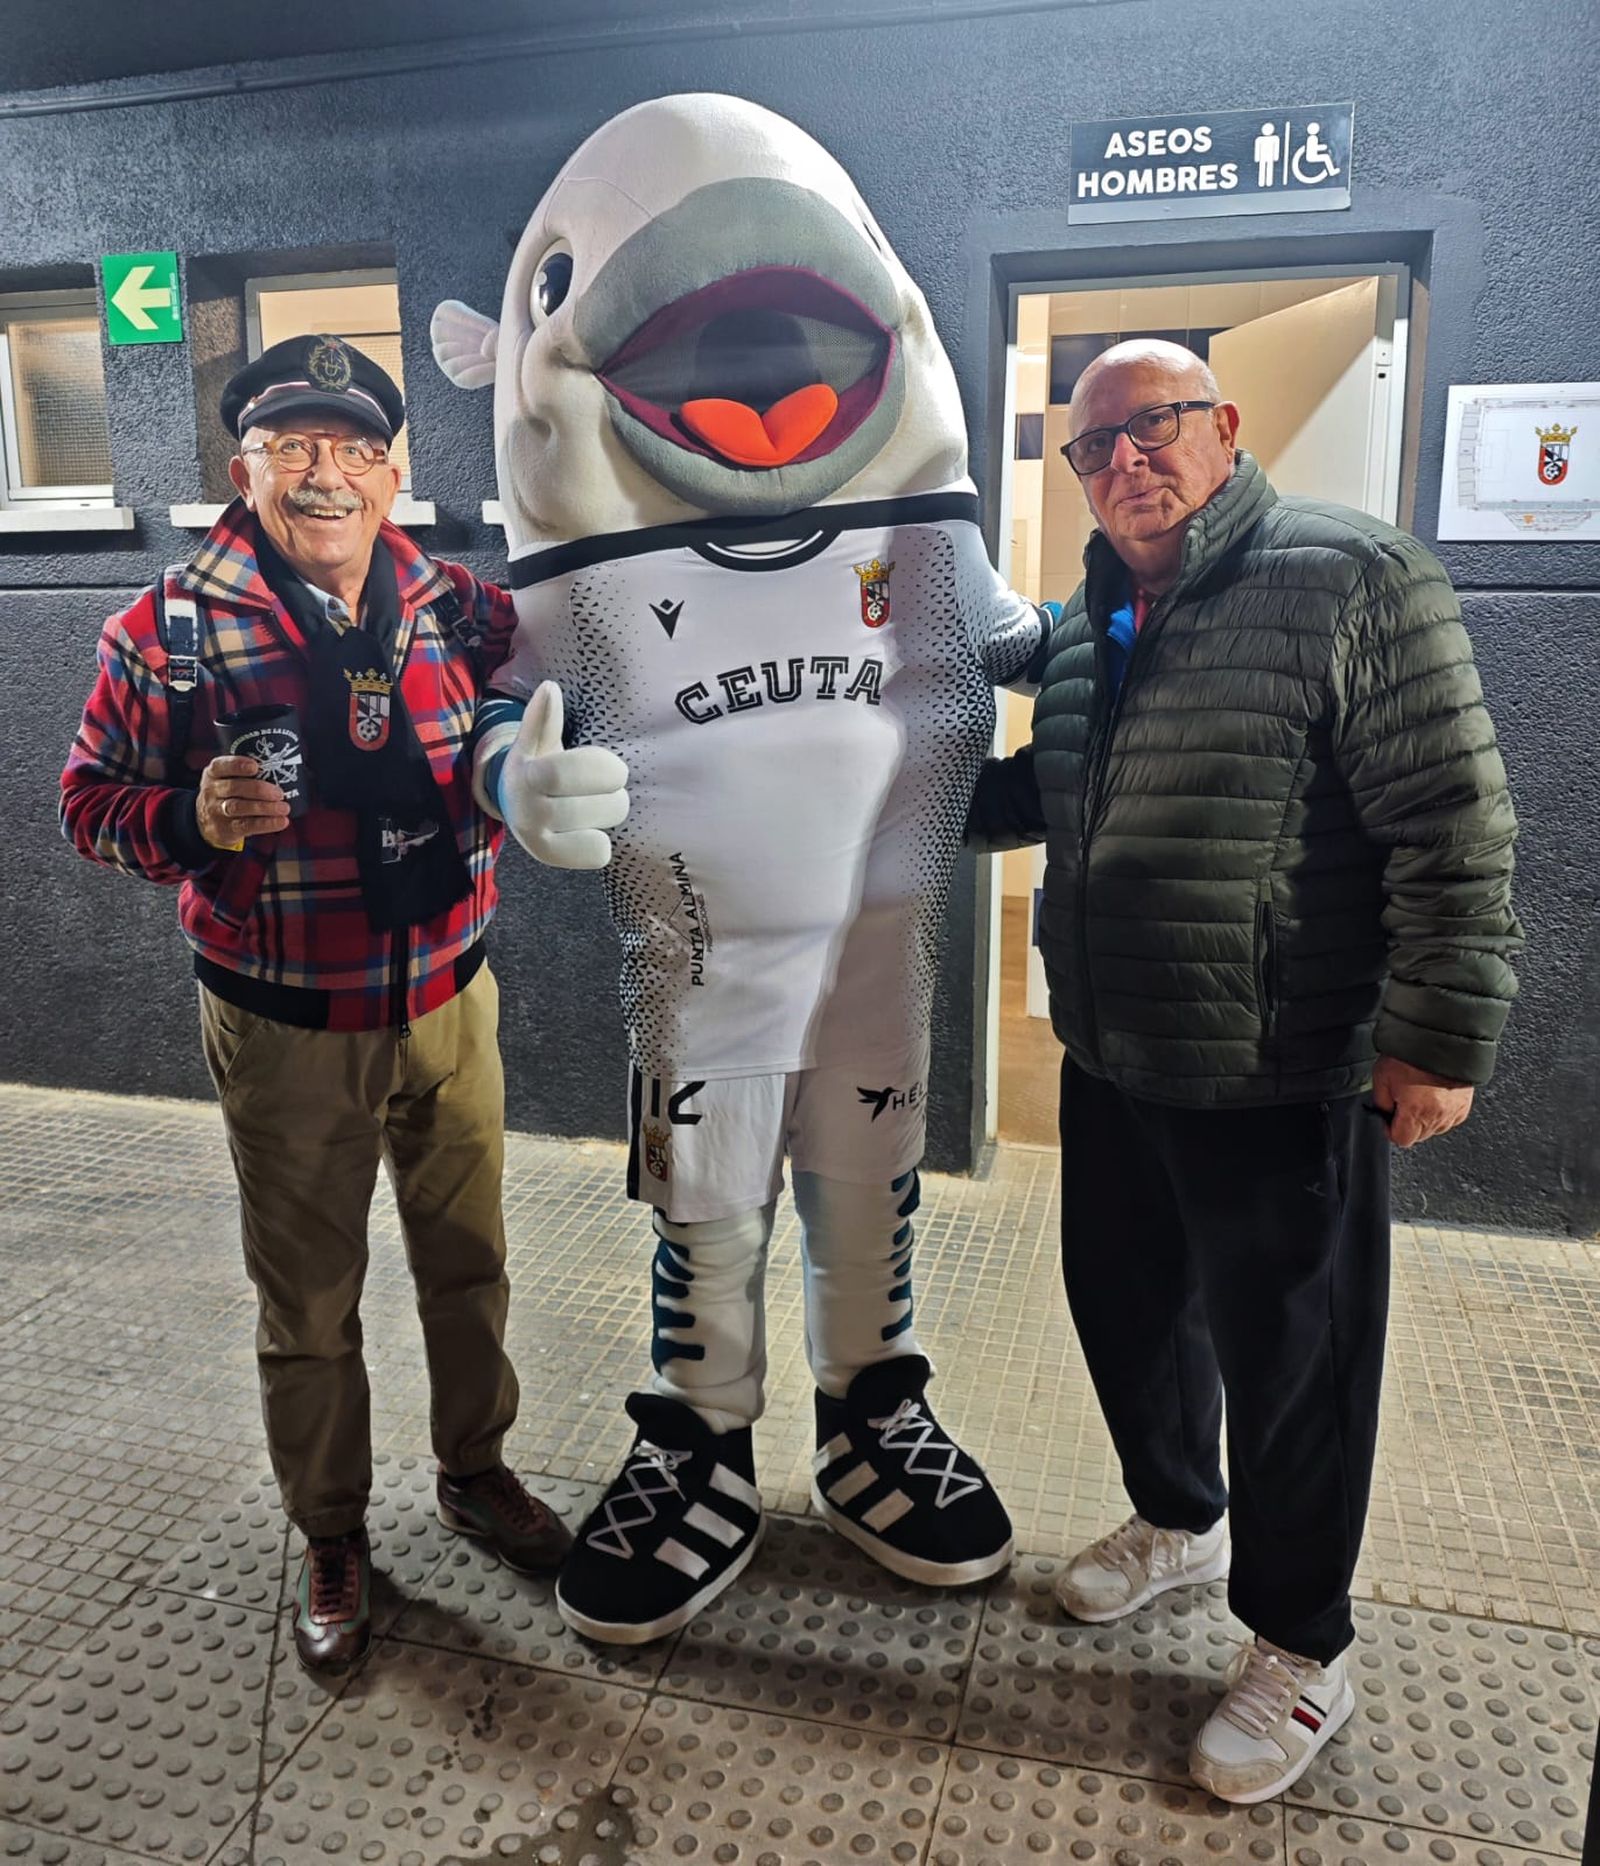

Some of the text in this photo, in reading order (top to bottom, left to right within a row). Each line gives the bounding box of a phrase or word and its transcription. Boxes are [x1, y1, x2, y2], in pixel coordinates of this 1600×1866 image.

[1104, 126, 1212, 159] ASEOS
[1077, 163, 1238, 198] HOMBRES
[674, 656, 884, 725] CEUTA
[669, 852, 705, 987] PUNTA ALMINA
